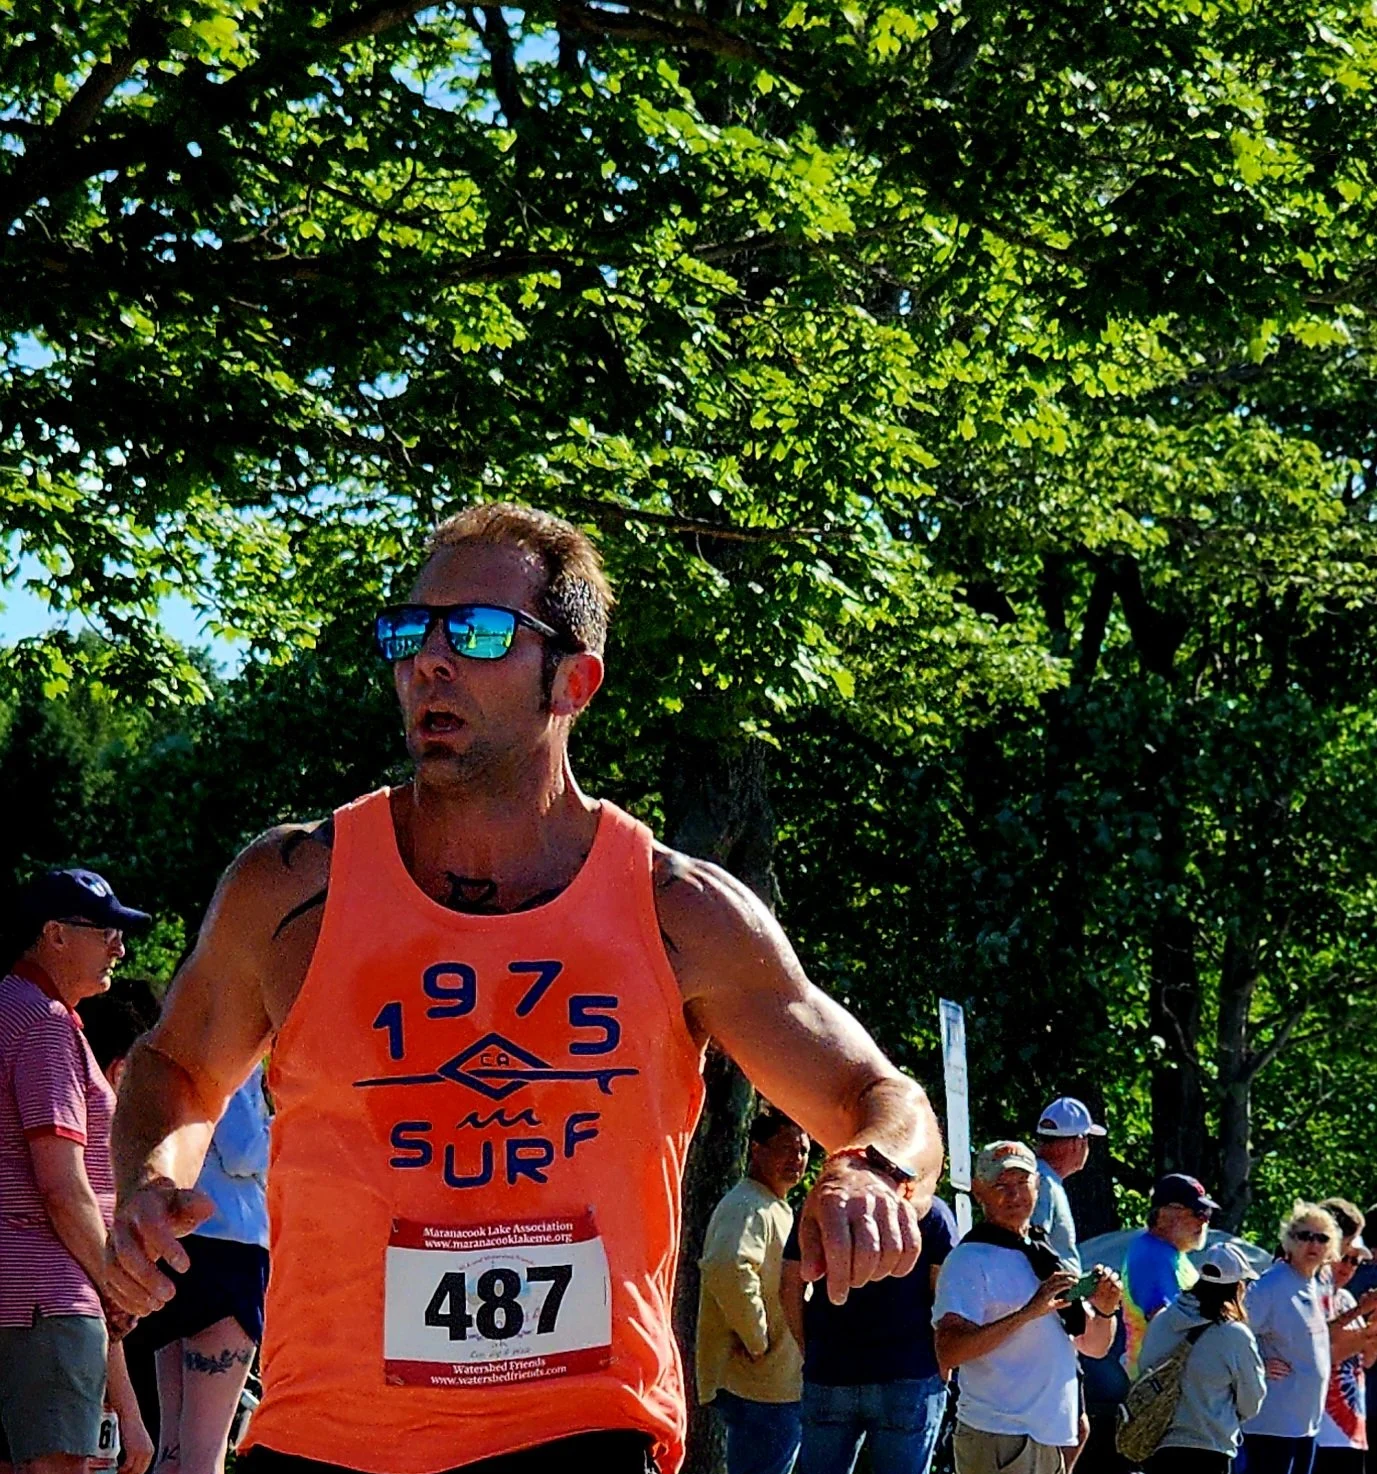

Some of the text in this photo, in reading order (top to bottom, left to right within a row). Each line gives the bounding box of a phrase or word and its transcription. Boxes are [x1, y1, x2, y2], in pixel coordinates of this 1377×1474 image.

[373, 961, 621, 1060] 1975
[480, 1053, 510, 1067] CA
[389, 1112, 601, 1188] SURF
[423, 1221, 574, 1239] Maranacook Lake Association
[424, 1233, 573, 1249] www.maranacooklakeme.org
[424, 1265, 573, 1341] 487
[430, 1365, 567, 1386] www.watershedfriends.com
[452, 1357, 547, 1375] Watershed Friends
